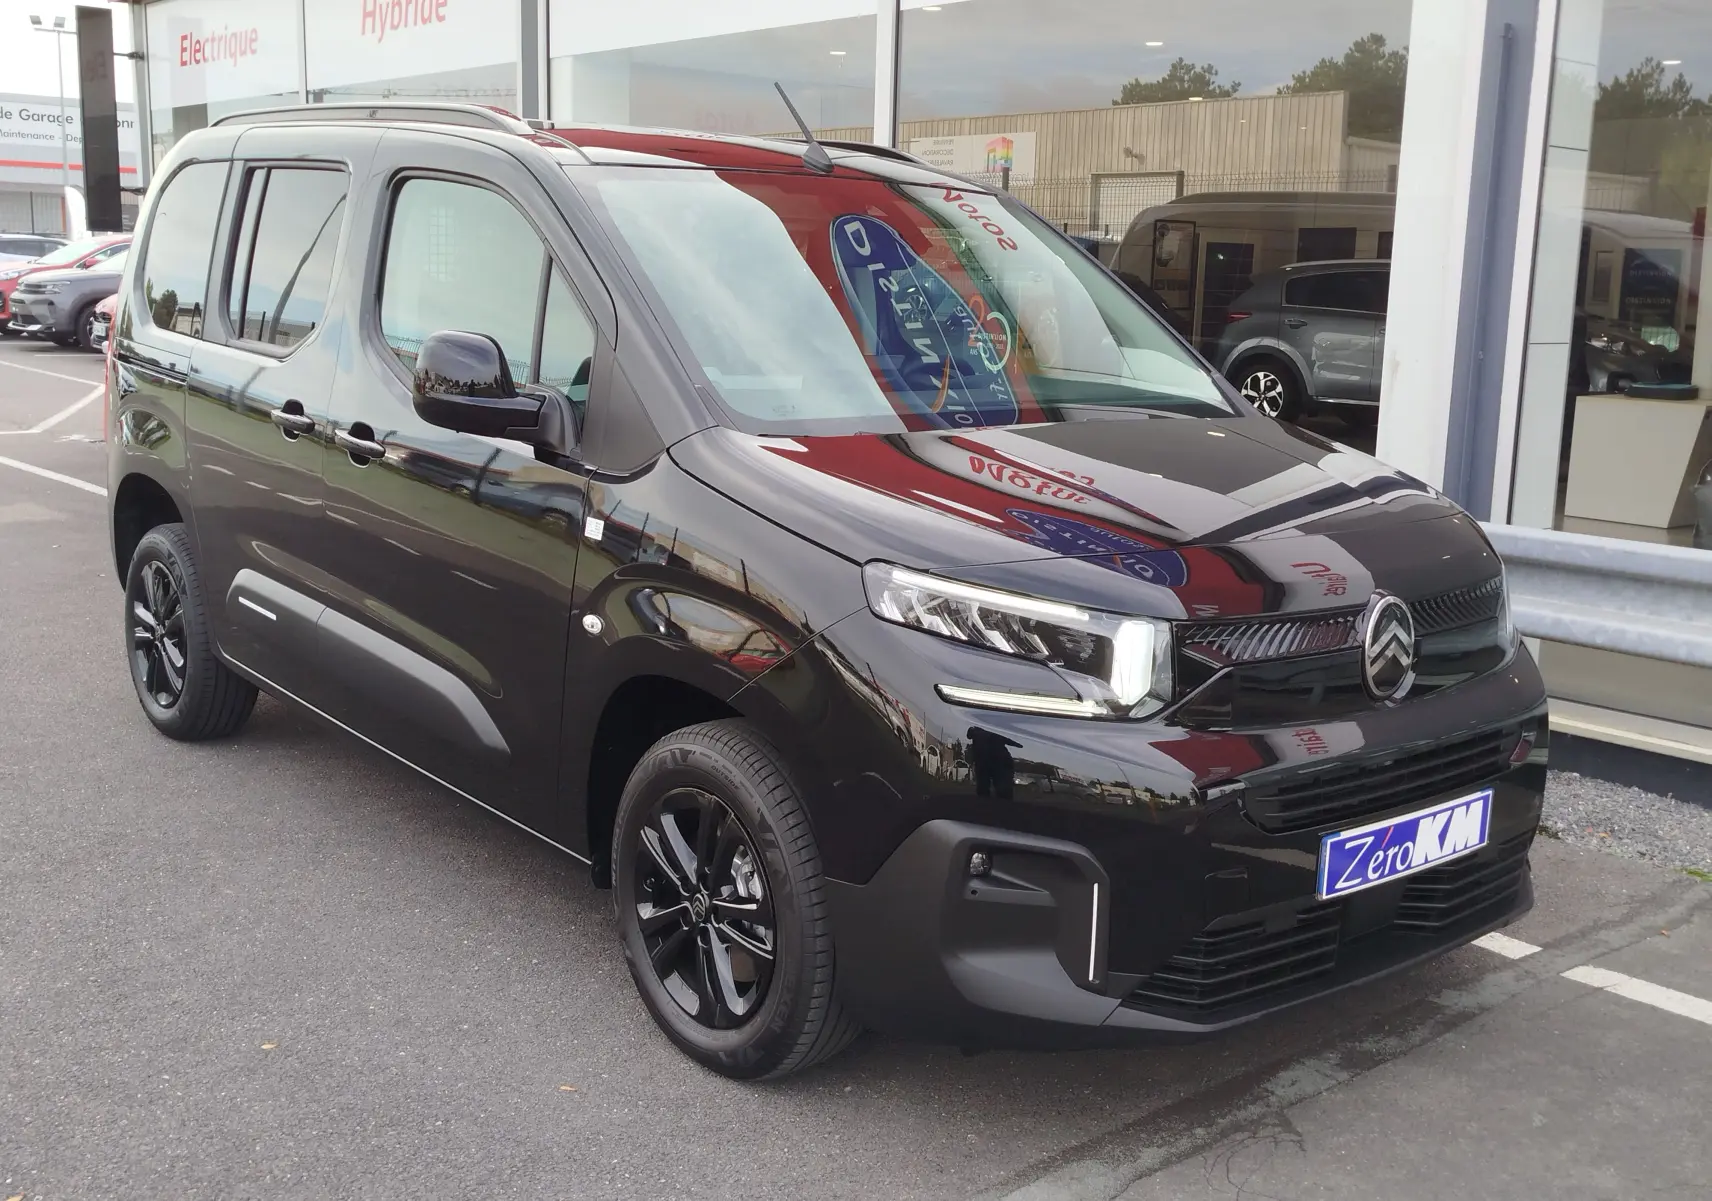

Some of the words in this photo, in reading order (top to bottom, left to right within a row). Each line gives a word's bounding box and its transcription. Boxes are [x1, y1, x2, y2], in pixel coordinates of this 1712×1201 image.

[360, 0, 448, 43] Hybride
[179, 23, 259, 67] Electrique
[18, 108, 74, 126] Garage
